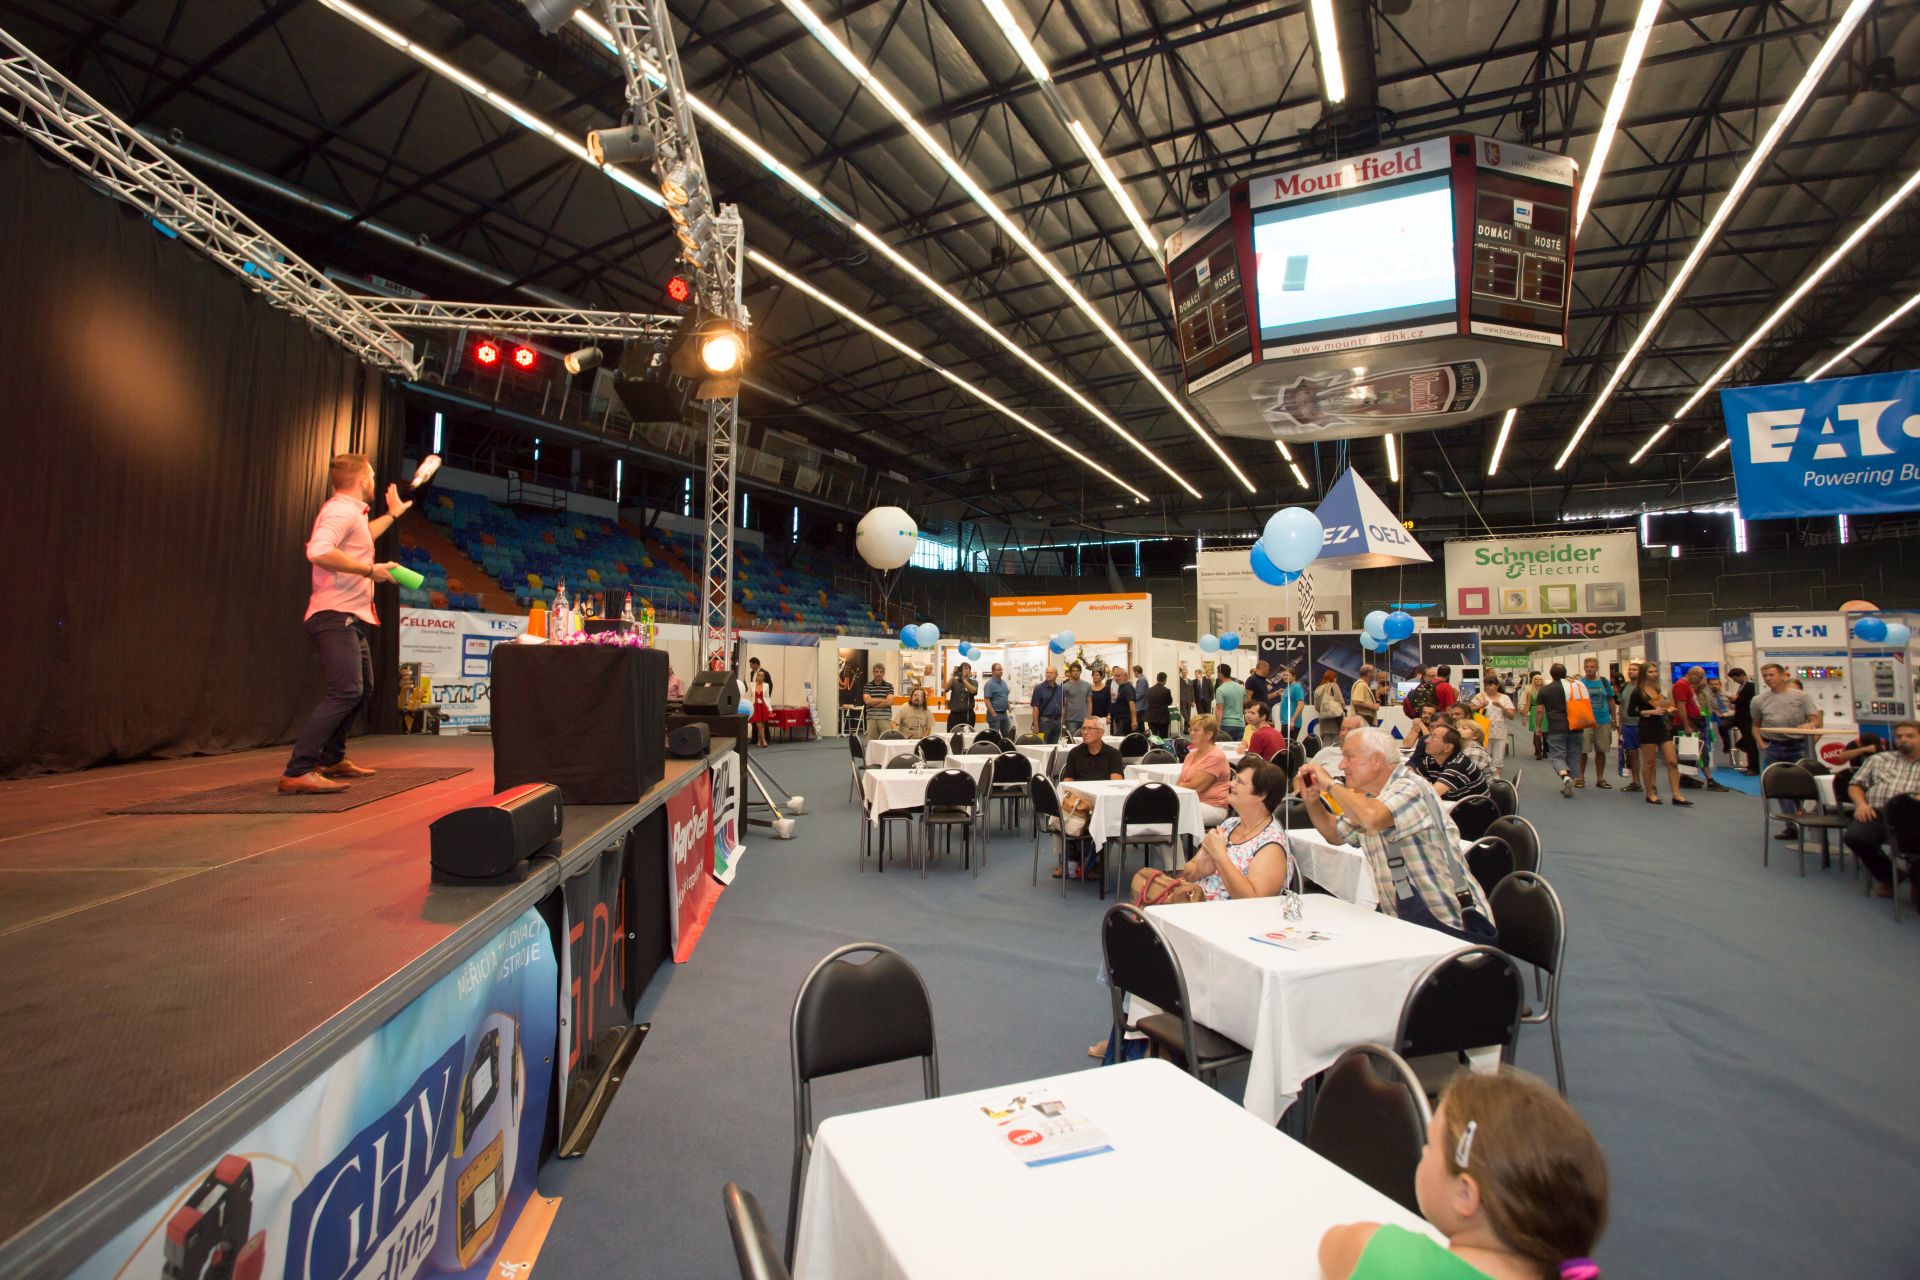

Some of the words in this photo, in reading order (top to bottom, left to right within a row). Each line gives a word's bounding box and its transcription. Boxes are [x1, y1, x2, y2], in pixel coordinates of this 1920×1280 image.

[1477, 224, 1512, 241] DOMÁCÍ
[1534, 235, 1561, 250] HOSTÉ
[1214, 269, 1236, 290] HOSTÉ
[1179, 291, 1201, 313] DOMÁCÍ
[1291, 329, 1424, 355] www.mountfildhk.cz
[1747, 399, 1920, 464] EATO
[1803, 466, 1894, 487] Powering
[1900, 463, 1920, 481] Bu
[1322, 525, 1351, 545] EZ
[1369, 524, 1405, 545] OEZ
[1475, 544, 1602, 566] Schneider
[1529, 563, 1600, 577] Electric
[401, 616, 455, 629] CELLPACK
[1460, 618, 1627, 639] www.vypinac.cz
[1772, 624, 1827, 638] EATON
[1261, 637, 1297, 651] OEZ
[1495, 658, 1509, 666] Life
[432, 682, 491, 703] TYMP
[303, 1065, 451, 1280] GHV
